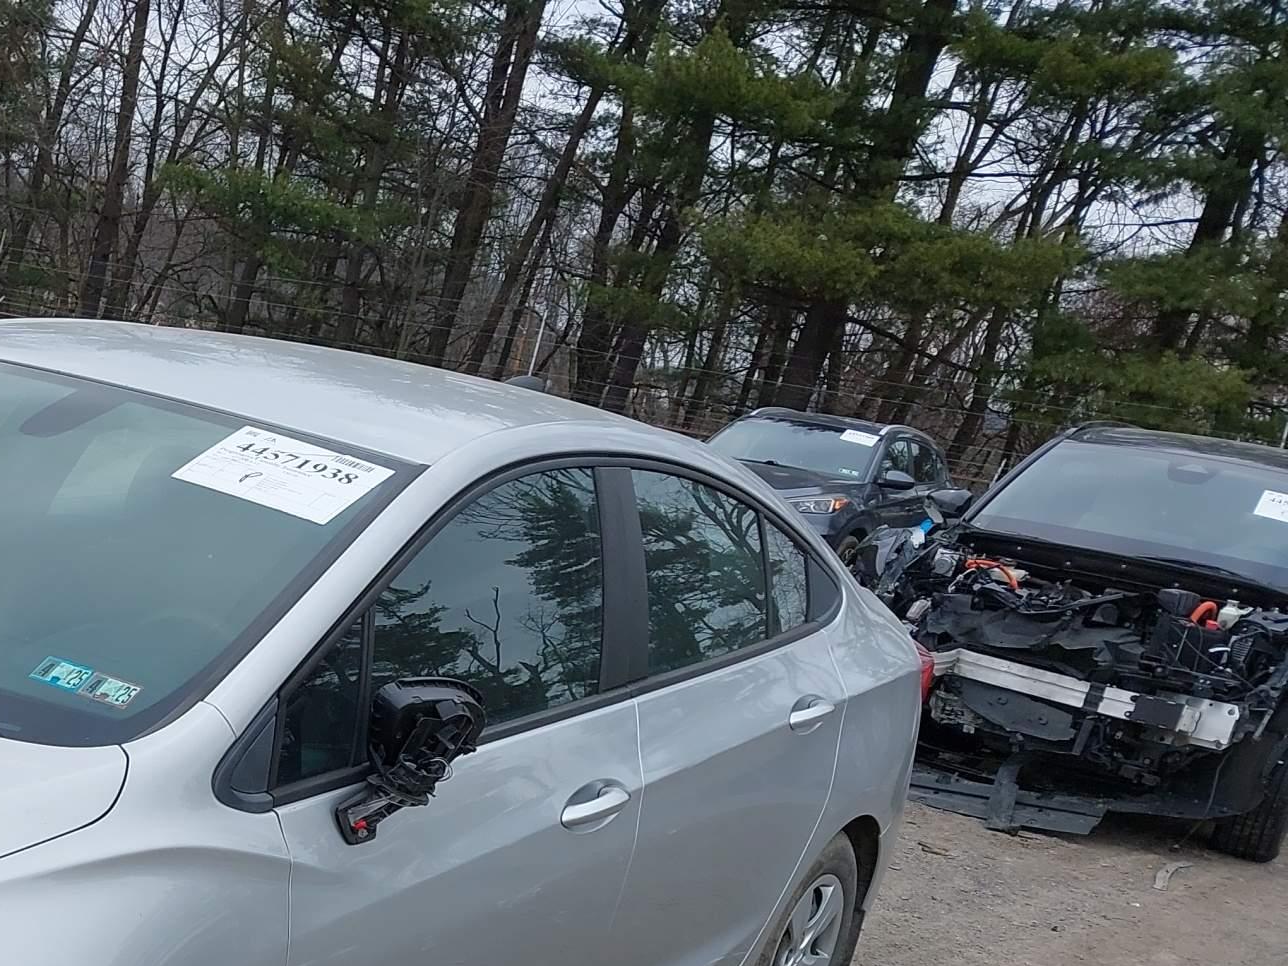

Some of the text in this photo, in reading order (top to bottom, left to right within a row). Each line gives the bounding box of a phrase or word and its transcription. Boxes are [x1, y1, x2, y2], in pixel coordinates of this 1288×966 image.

[236, 442, 359, 485] 44571938
[38, 663, 55, 677] 4
[66, 670, 89, 686] 25
[86, 679, 102, 694] 4
[115, 686, 137, 703] 25
